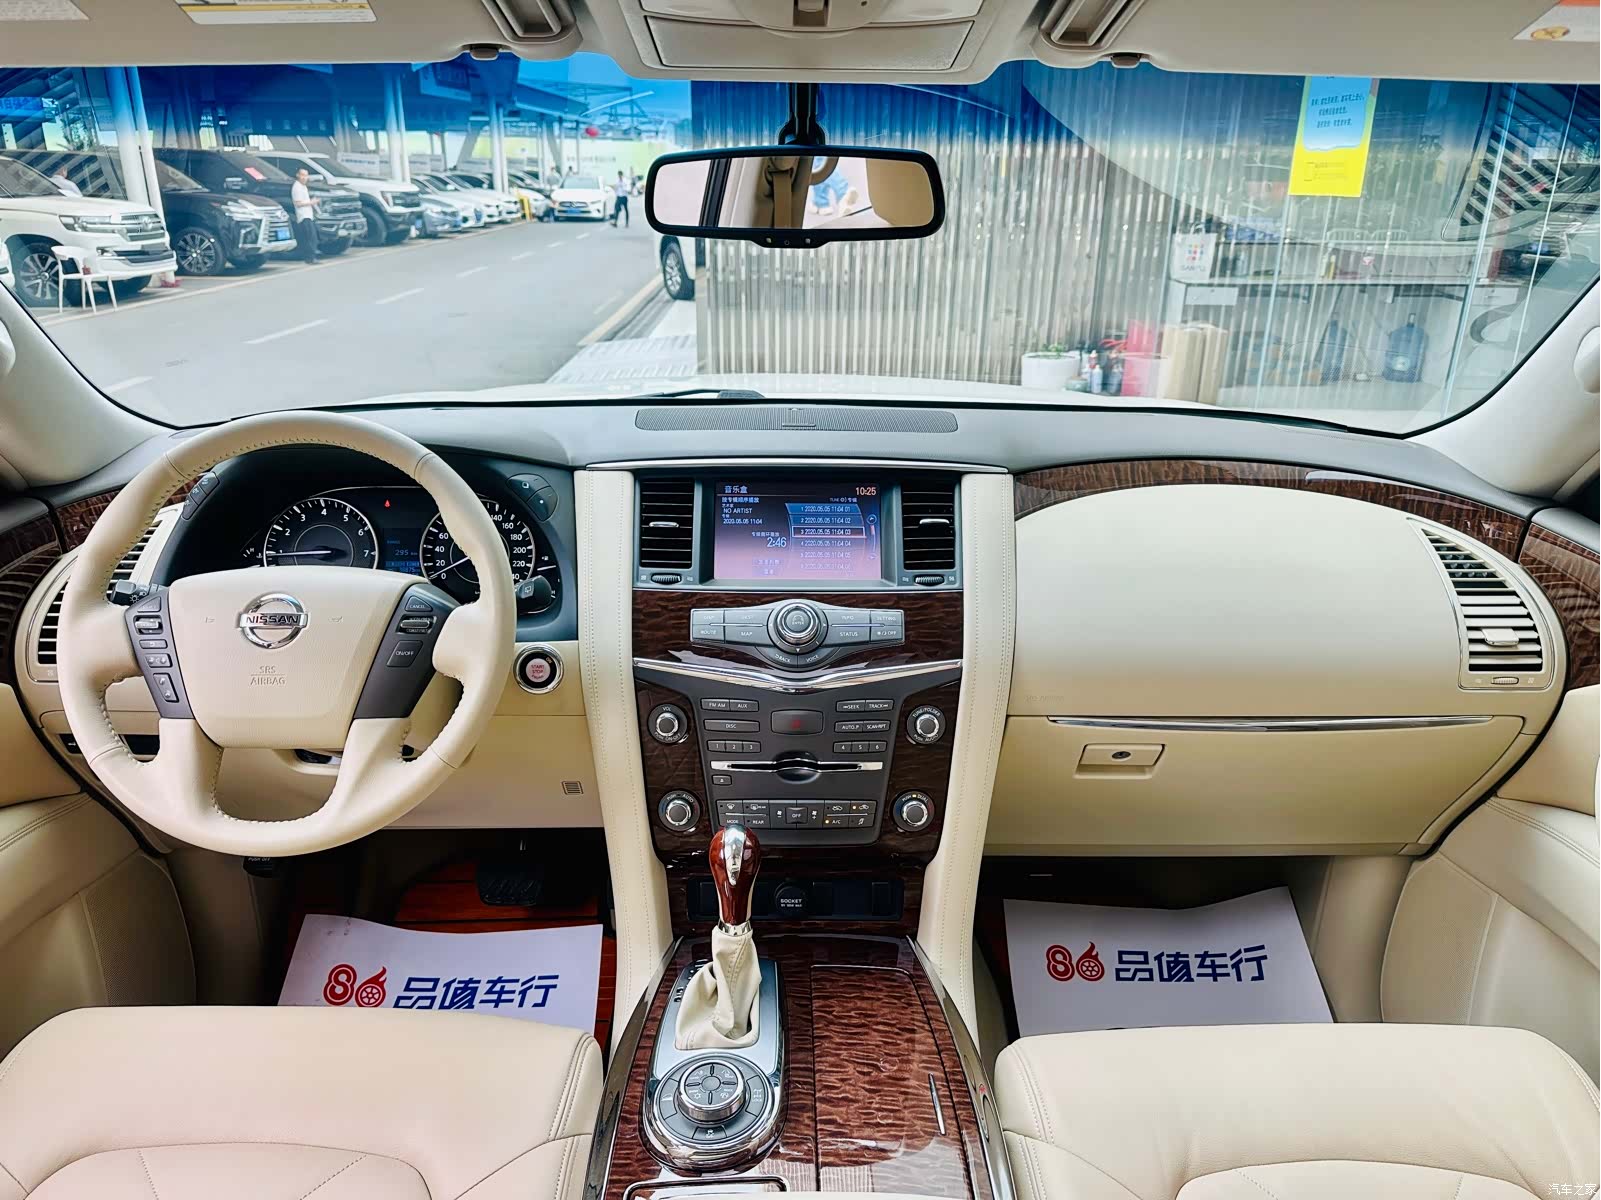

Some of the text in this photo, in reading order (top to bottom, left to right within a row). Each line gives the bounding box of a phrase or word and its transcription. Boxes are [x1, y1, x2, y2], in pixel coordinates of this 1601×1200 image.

[725, 485, 748, 494] 音乐盒
[855, 486, 877, 496] 10:25
[511, 533, 523, 541] 180
[767, 536, 787, 548] 2:46
[246, 615, 299, 624] NISSAN
[259, 666, 276, 674] SRS
[250, 677, 286, 686] AIRBAG
[1115, 944, 1268, 983] 品值车行
[392, 974, 559, 1010] 品值车行
